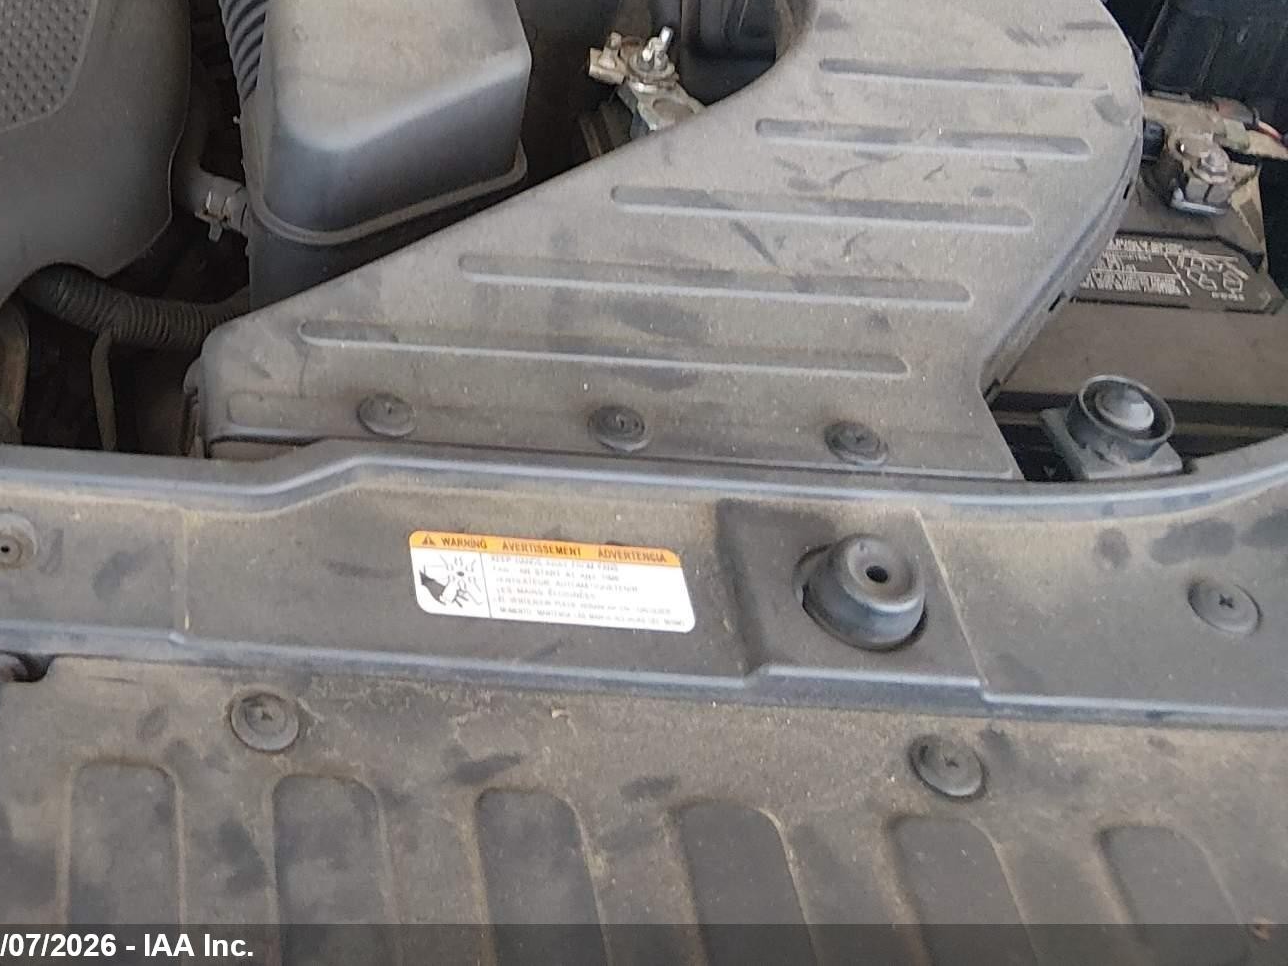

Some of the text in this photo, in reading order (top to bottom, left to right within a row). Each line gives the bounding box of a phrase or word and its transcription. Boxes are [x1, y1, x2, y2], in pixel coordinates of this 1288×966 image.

[441, 537, 487, 551] WARNING
[502, 541, 582, 557] AVERTISSEMENT
[598, 546, 667, 564] ADVERTENCIA
